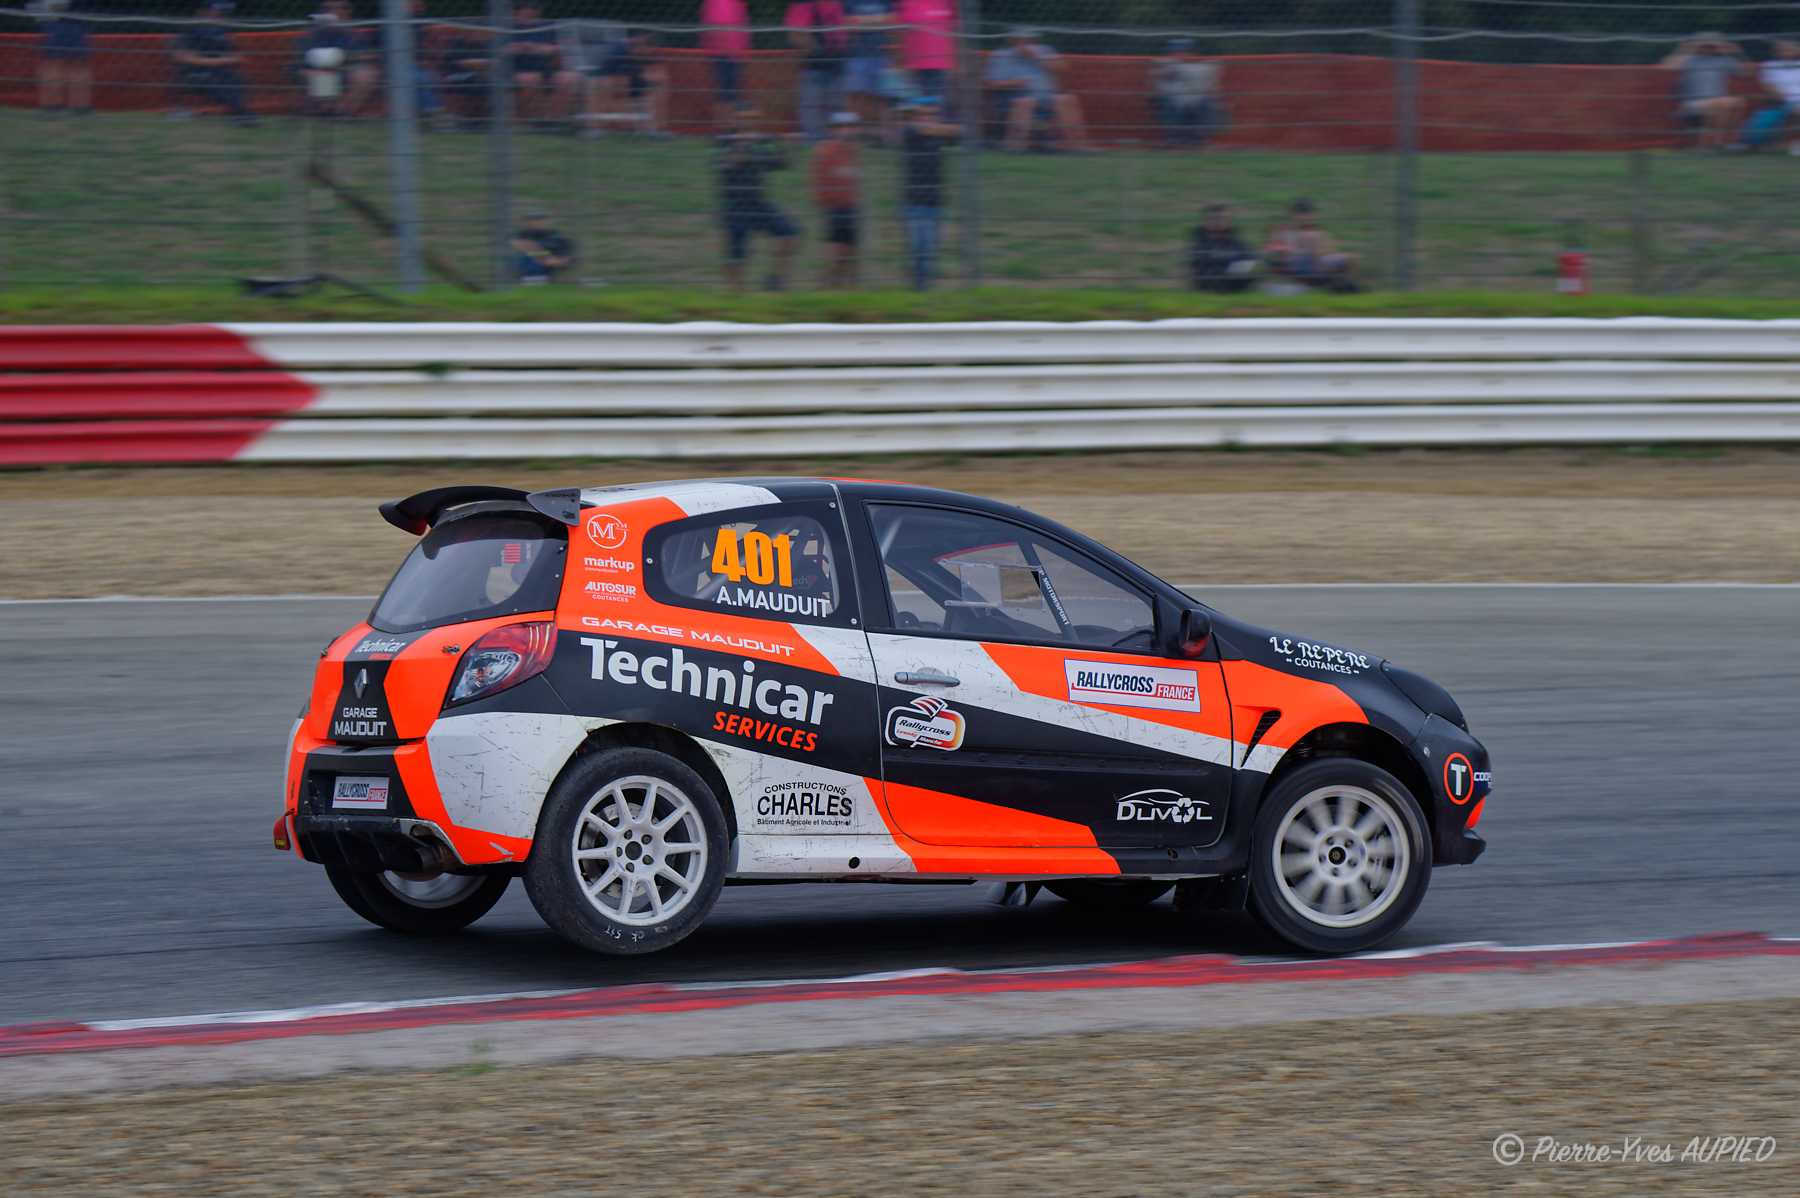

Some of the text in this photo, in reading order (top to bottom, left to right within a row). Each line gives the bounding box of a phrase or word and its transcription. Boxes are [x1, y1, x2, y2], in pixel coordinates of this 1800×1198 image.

[584, 557, 635, 572] markup
[711, 528, 793, 587] 401
[584, 581, 637, 596] AUTOSUR
[716, 586, 831, 618] A.MAUDUIT
[582, 616, 796, 657] GARAGE MAUDUIT
[1269, 636, 1371, 669] LE REPERE
[1294, 657, 1352, 674] COUTANCES
[580, 637, 835, 726] Technicar
[1076, 670, 1195, 700] RALLYCROSS FRANCE
[343, 707, 378, 718] GARAGE
[334, 721, 387, 736] MAUDUIT
[712, 711, 819, 752] SERVICES
[898, 719, 952, 737] Rallycross
[764, 781, 847, 796] CONSTRUCTIONS
[757, 792, 853, 816] CHARLES
[785, 818, 811, 827] Agricole
